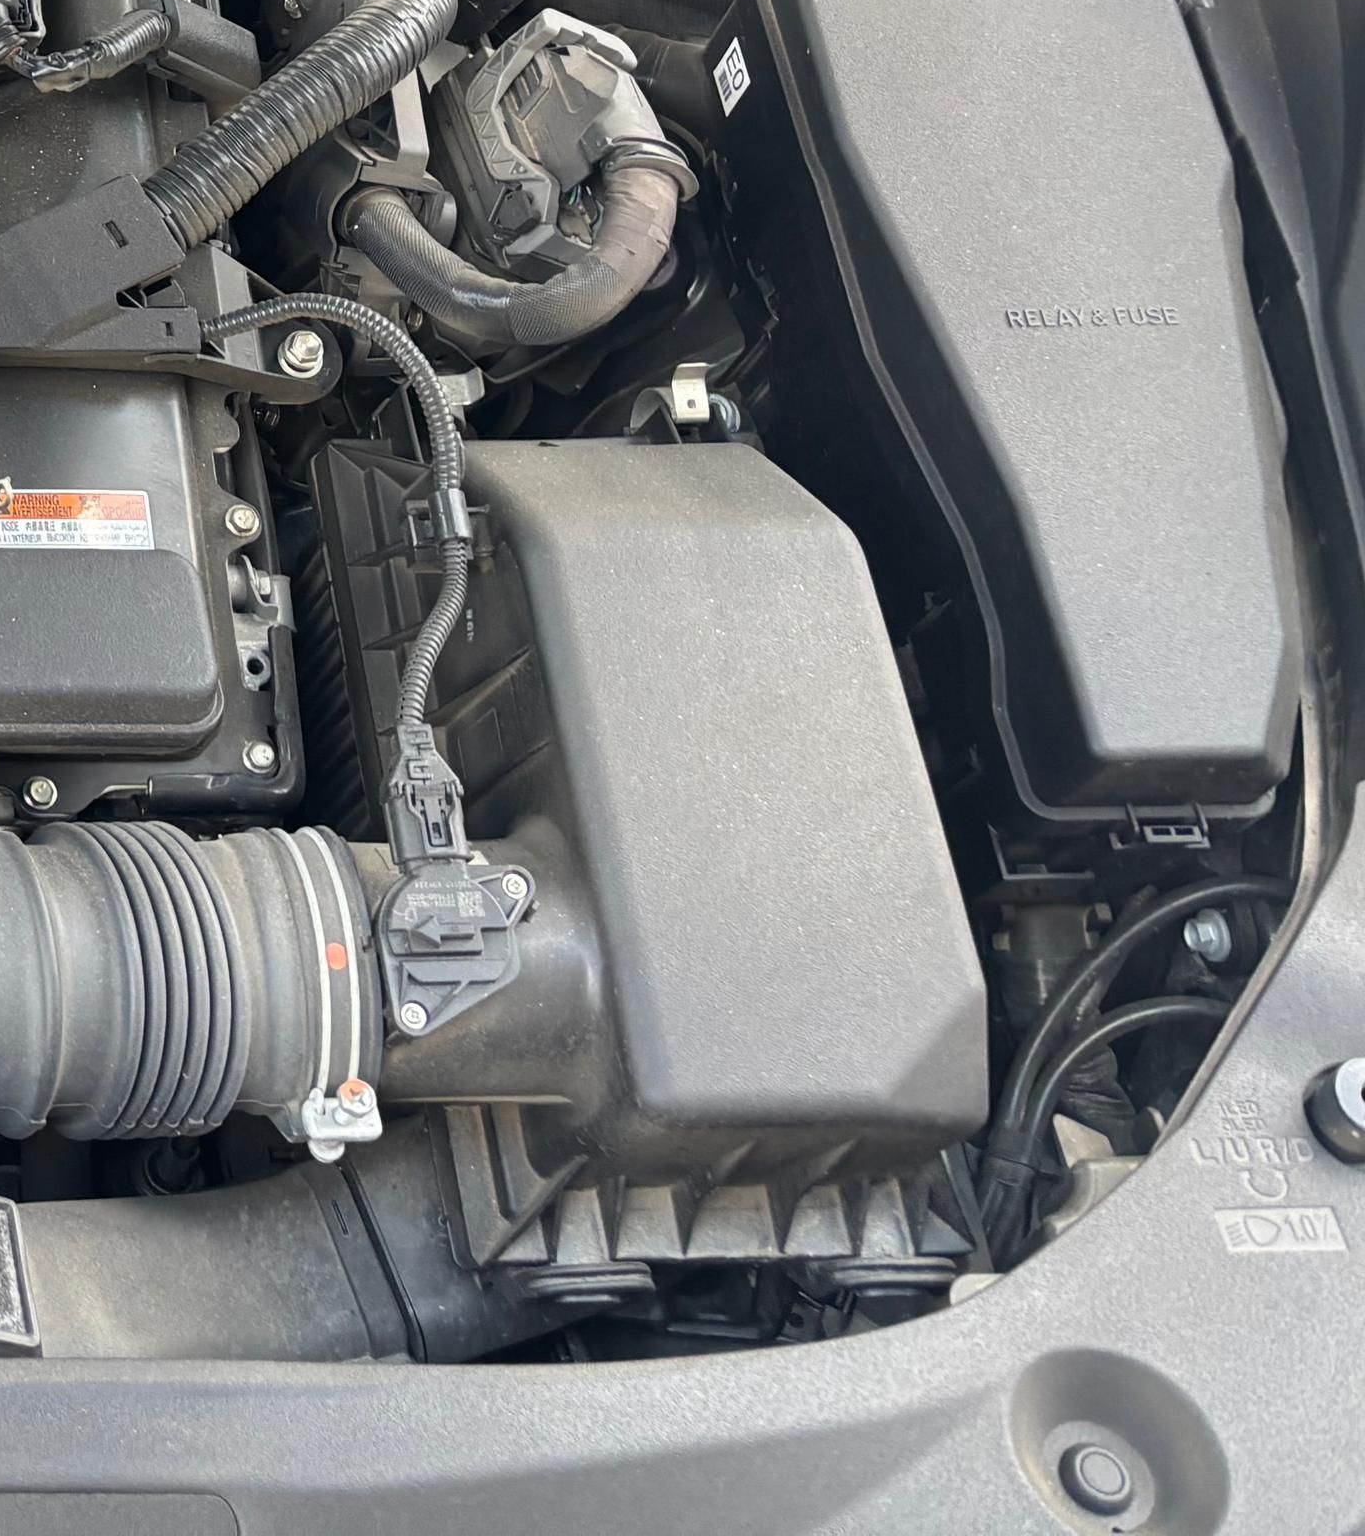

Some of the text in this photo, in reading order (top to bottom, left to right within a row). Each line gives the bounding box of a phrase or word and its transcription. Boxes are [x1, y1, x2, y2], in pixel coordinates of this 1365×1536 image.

[1005, 306, 1181, 328] RELAY & FUSE
[11, 494, 60, 506] WARNING
